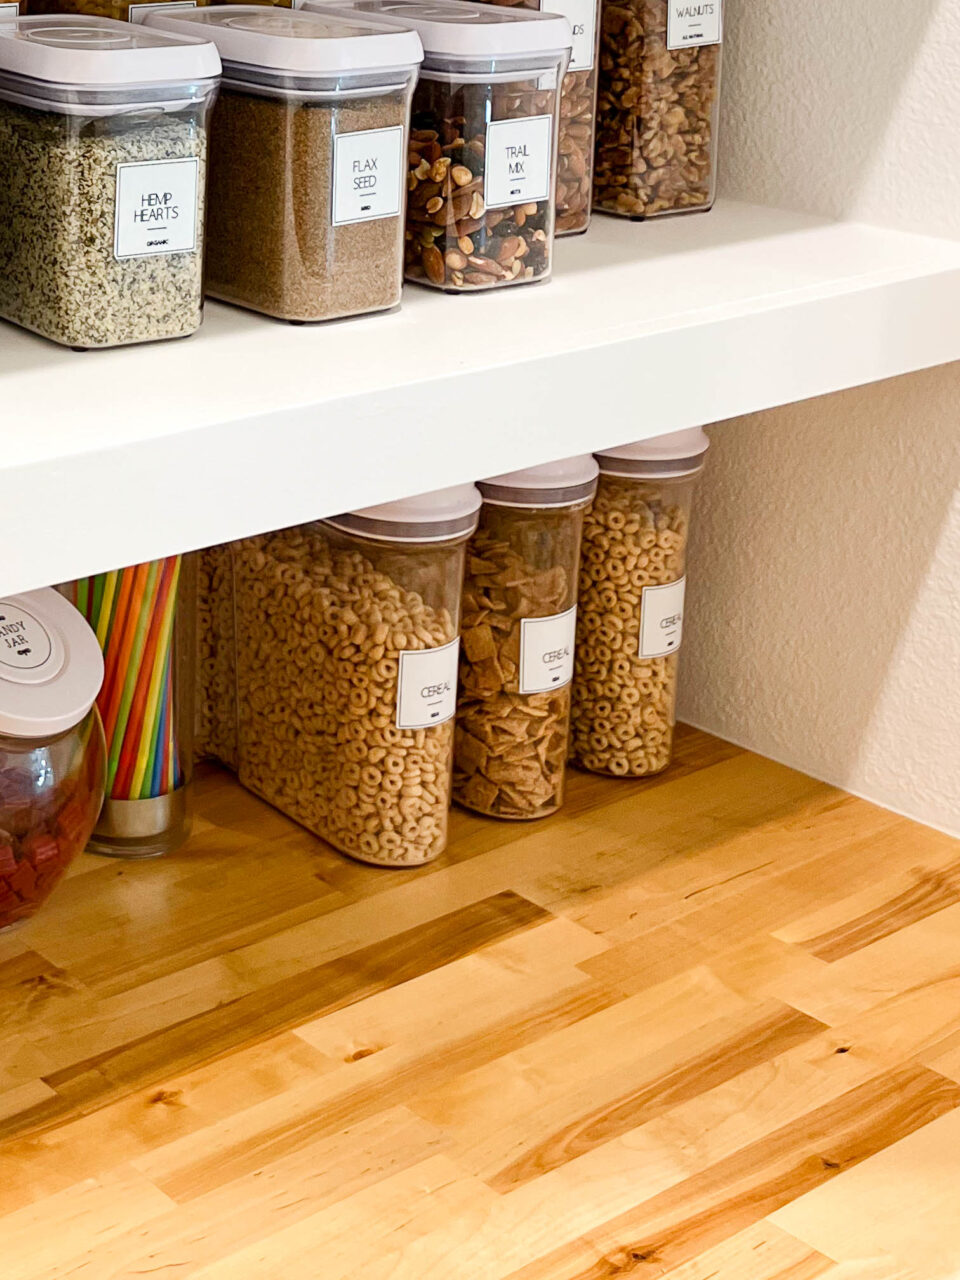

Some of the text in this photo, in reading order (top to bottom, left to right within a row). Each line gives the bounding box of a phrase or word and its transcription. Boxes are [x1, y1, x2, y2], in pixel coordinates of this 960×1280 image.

[675, 3, 715, 19] WALNUTS
[505, 144, 530, 160] TRAIL
[352, 157, 378, 173] FLAX
[508, 160, 525, 175] MIX
[352, 174, 377, 191] SEED
[141, 191, 173, 208] HEMP
[133, 205, 180, 223] HEARTS
[4, 634, 29, 649] JAR
